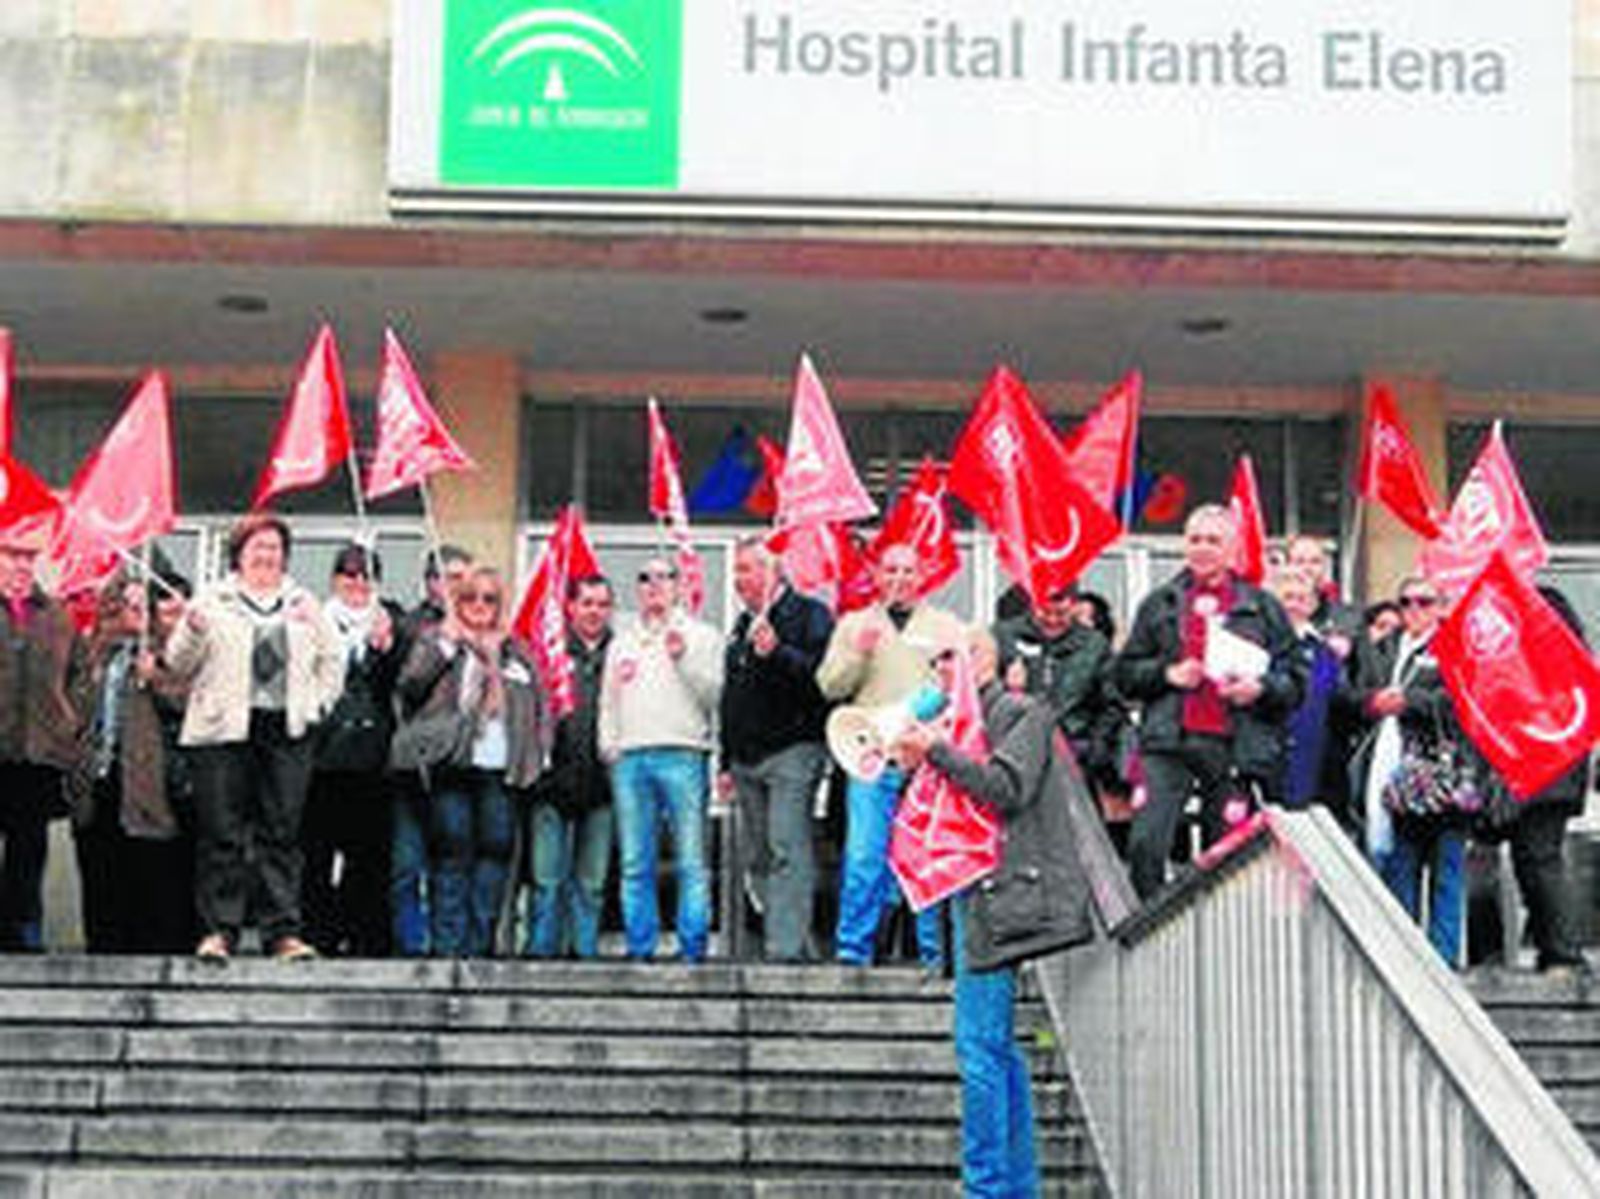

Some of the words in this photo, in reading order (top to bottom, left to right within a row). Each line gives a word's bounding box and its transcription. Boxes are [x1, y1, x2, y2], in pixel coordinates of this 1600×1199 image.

[743, 14, 1024, 92] Hospital
[1060, 21, 1288, 88] Infanta
[1322, 30, 1506, 96] Elena
